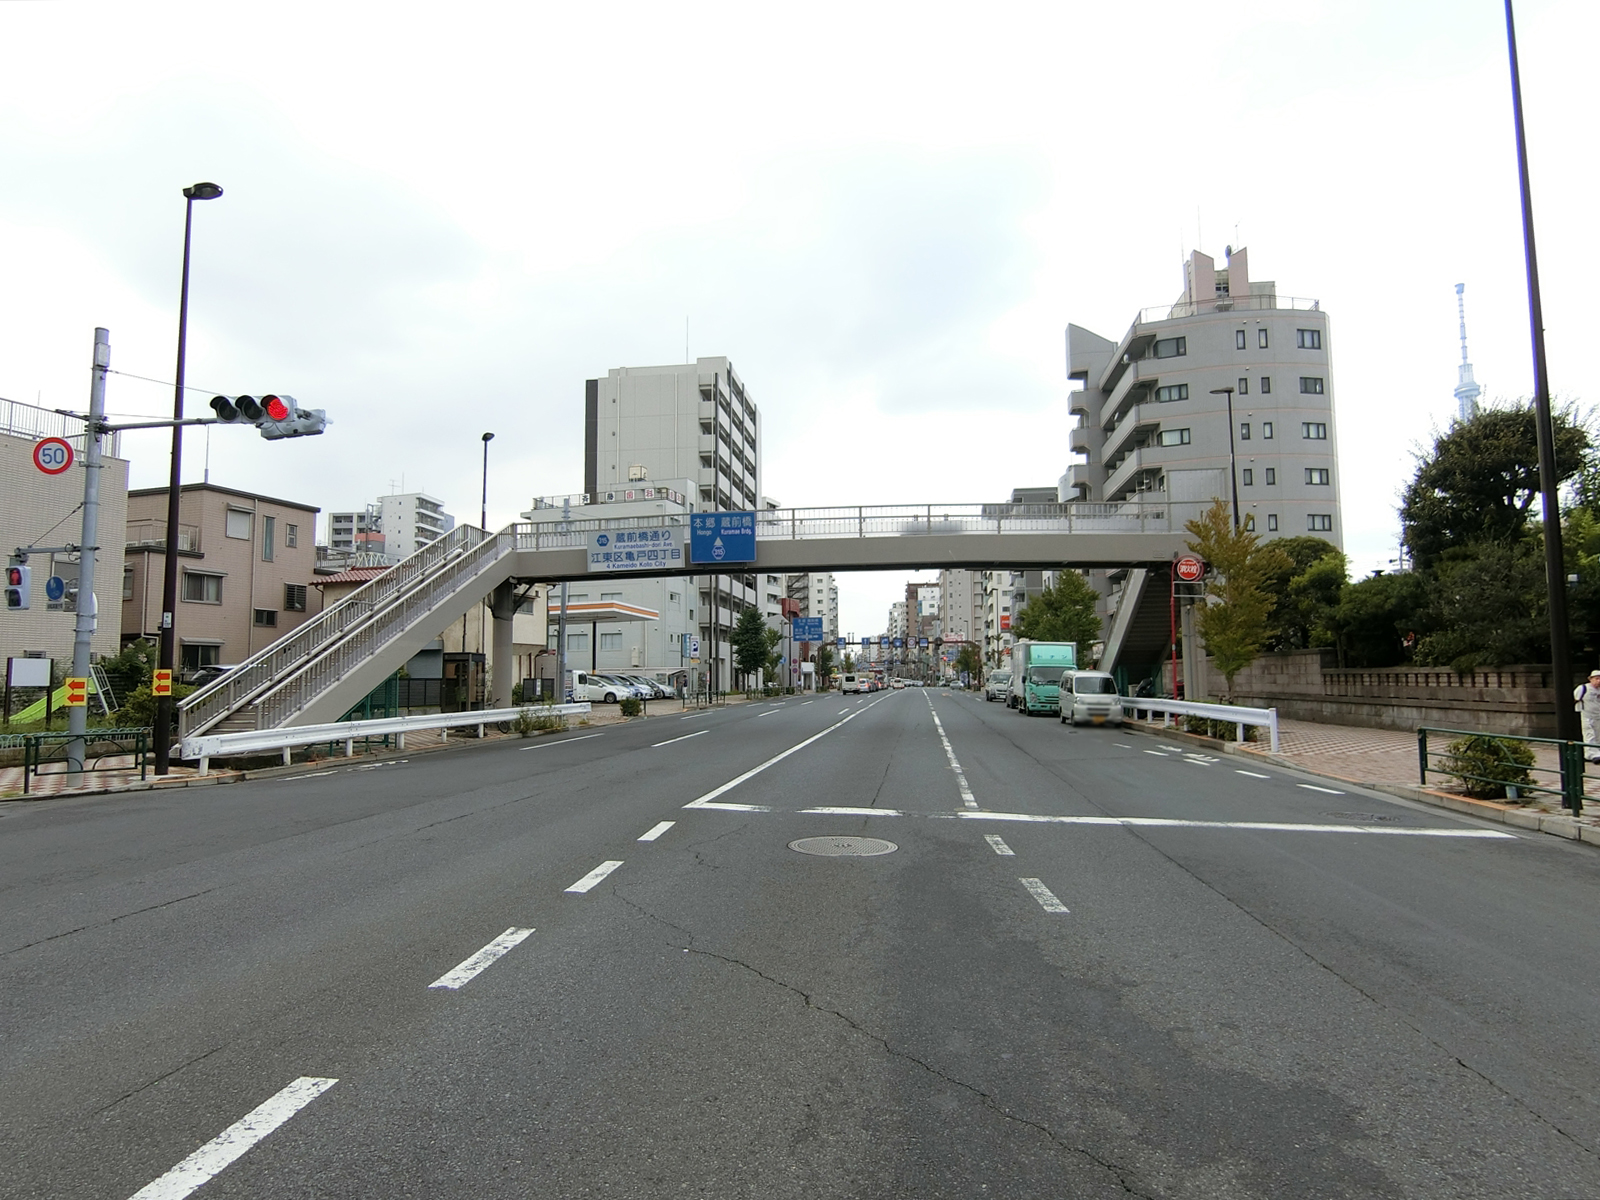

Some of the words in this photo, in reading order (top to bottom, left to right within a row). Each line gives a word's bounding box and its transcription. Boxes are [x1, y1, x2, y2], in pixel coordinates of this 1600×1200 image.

[42, 447, 65, 464] 50
[693, 517, 716, 529] 本郷
[720, 516, 752, 528] 蔵前橋
[615, 530, 671, 543] 蔵前橋通り
[591, 548, 681, 563] 江東区亀戸四丁目
[654, 560, 667, 568] City
